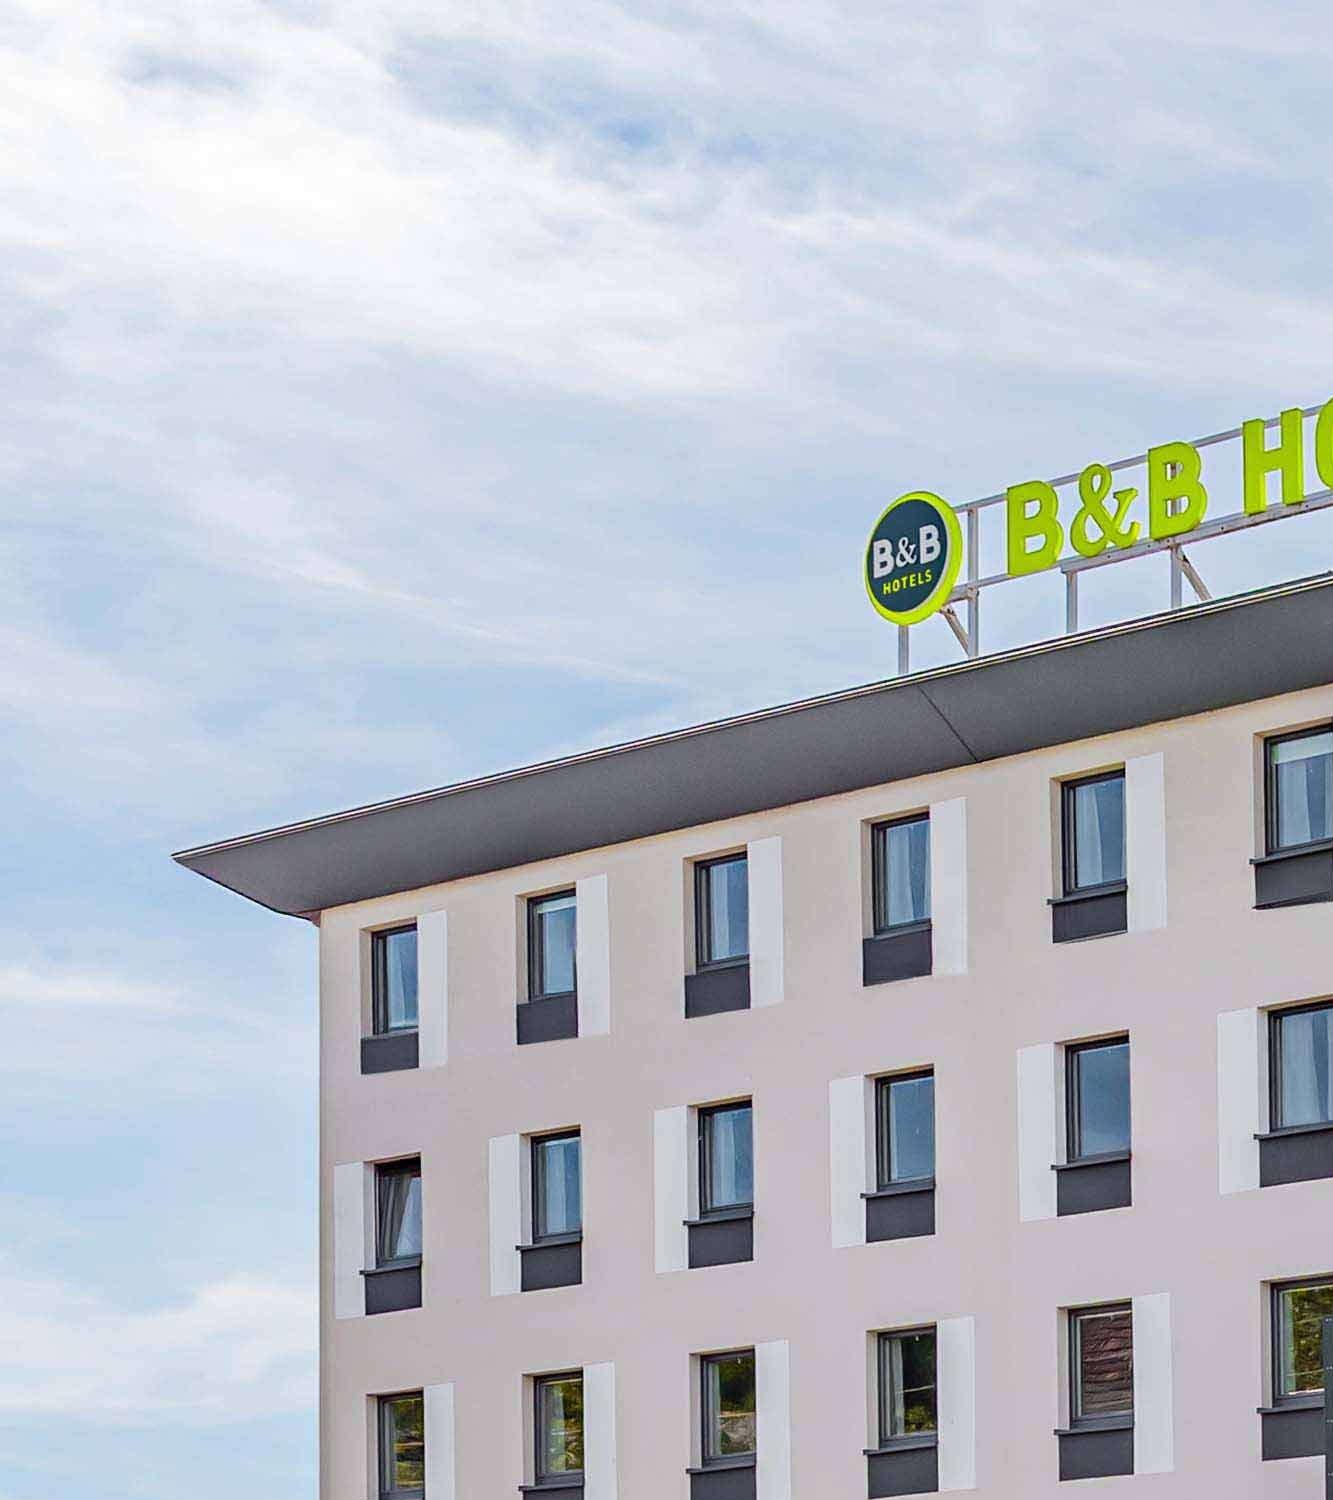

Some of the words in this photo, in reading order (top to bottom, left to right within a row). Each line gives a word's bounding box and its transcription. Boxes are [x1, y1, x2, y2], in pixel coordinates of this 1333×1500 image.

[1006, 441, 1208, 577] B&B
[873, 524, 941, 579] B&B
[883, 568, 933, 595] HOTELS
